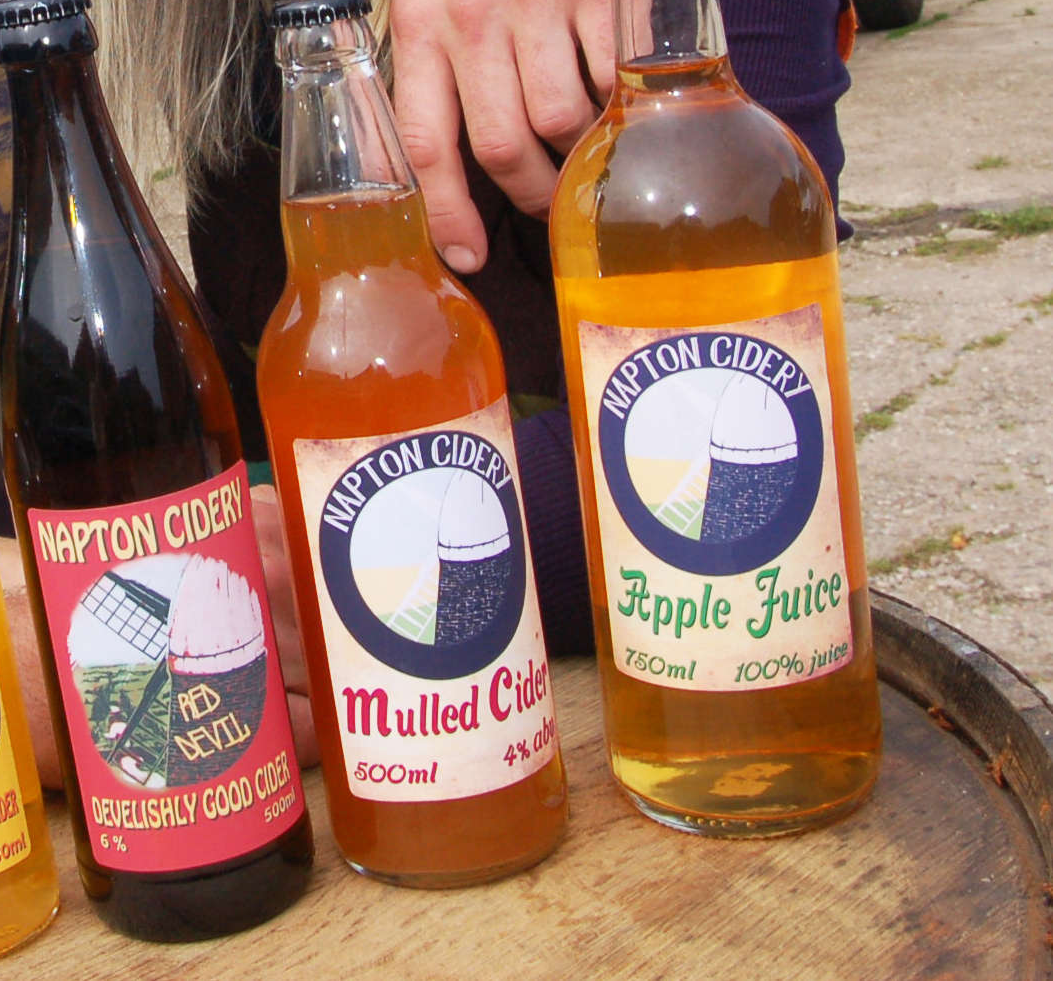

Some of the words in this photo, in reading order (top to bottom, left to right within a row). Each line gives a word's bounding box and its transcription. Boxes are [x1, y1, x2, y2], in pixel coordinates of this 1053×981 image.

[603, 336, 701, 419] NAPTON
[710, 335, 812, 399] CIDERY
[324, 443, 424, 533] NAPTON
[431, 434, 512, 490] CIDERY
[37, 512, 159, 564] NAPTON
[164, 477, 244, 549] CIDERY
[617, 565, 731, 638] Apple
[747, 565, 842, 638] Juice
[625, 647, 696, 680] 750ml
[734, 653, 804, 682] 100%
[808, 641, 848, 677] juice
[176, 683, 221, 722] RED
[489, 659, 547, 722] Cider
[174, 712, 251, 762] DEVIL
[503, 739, 530, 766] 4%
[91, 791, 197, 830] DEVELISHLY
[202, 780, 253, 821] GOOD
[255, 750, 291, 802] CIDER
[354, 761, 438, 784] 500ml
[264, 788, 296, 823] 500ml
